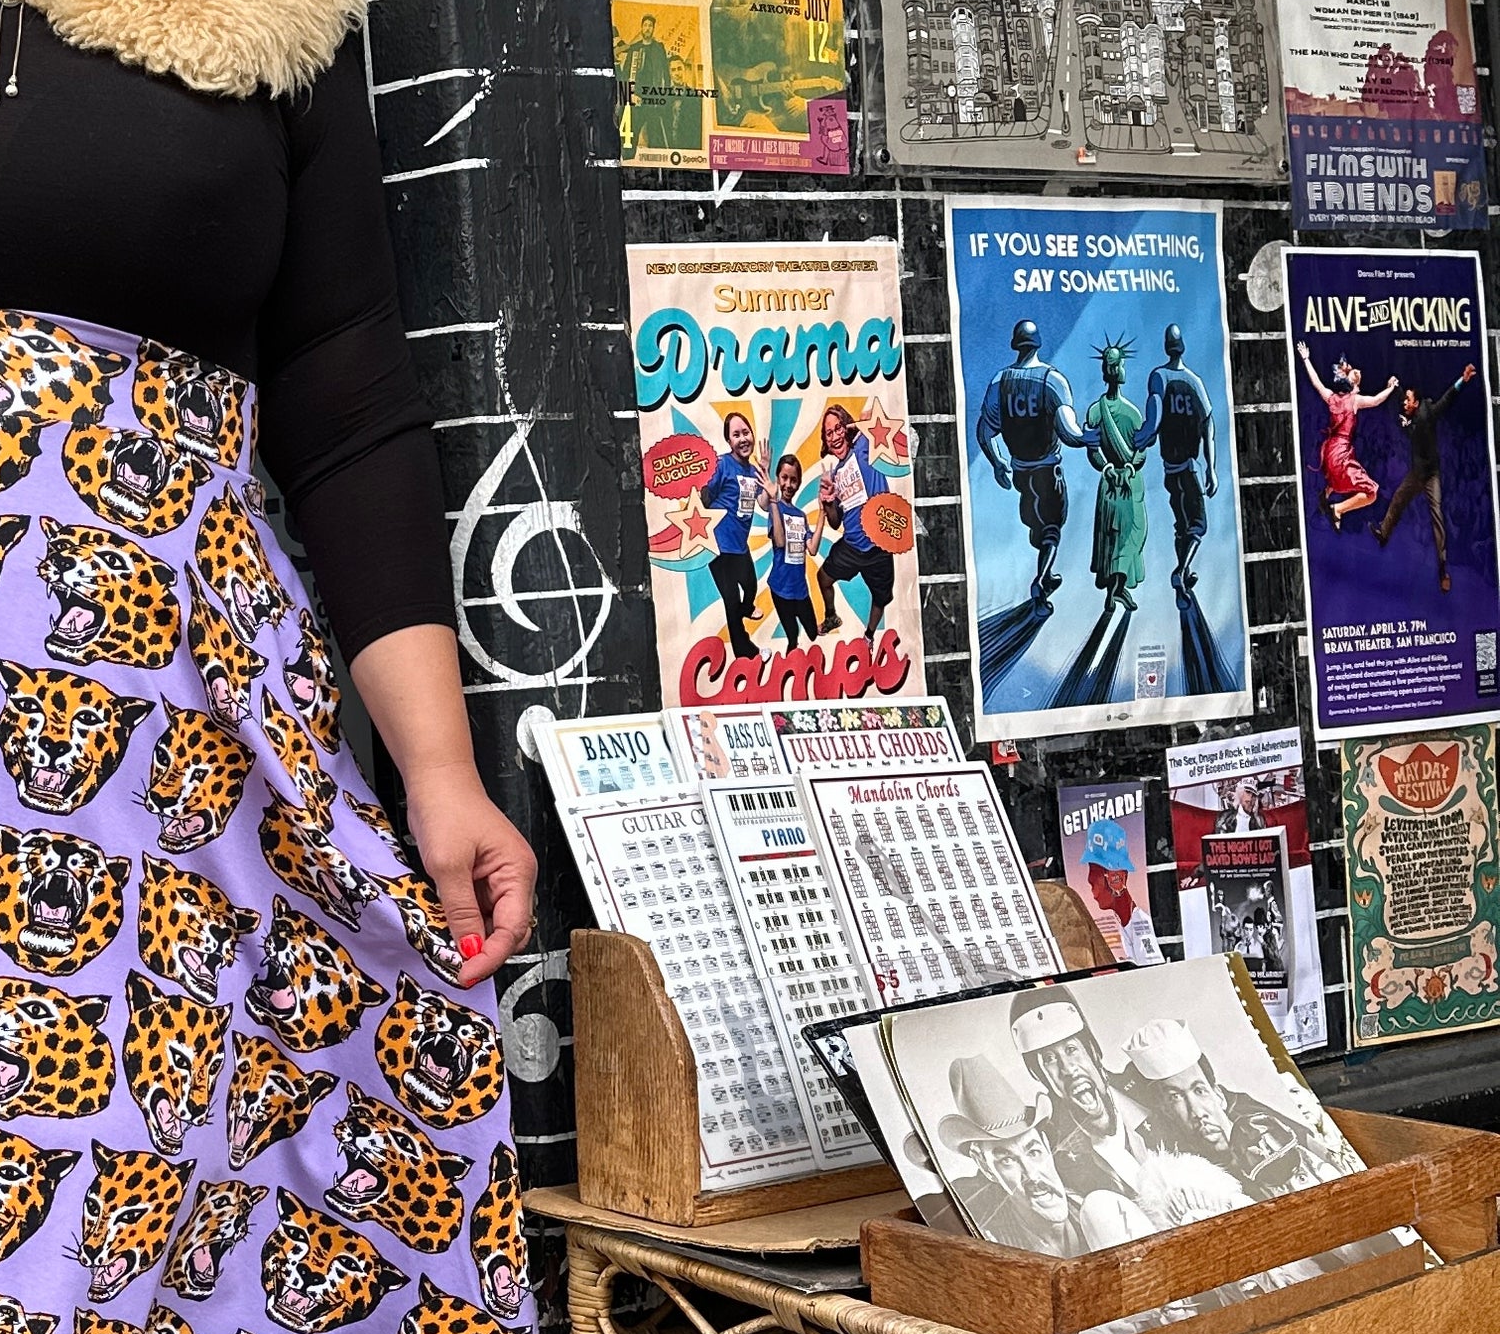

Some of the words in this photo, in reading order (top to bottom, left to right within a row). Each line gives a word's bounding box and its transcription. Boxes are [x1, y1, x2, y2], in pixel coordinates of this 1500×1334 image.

[1306, 182, 1433, 211] FRIENDS
[970, 233, 989, 257] IF
[995, 233, 1041, 257] YOU
[1046, 234, 1079, 257] SEE
[1087, 234, 1205, 262] SOMETHING,
[776, 261, 828, 273] THEATRE
[831, 260, 878, 272] CENTER
[1013, 270, 1054, 293] SAY
[1060, 269, 1180, 293] SOMETHING.
[714, 284, 833, 313] Summer
[1304, 296, 1369, 332] ALIVE
[1369, 302, 1389, 326] AND
[1390, 298, 1471, 331] KICKING
[636, 307, 903, 412] Drama
[1006, 393, 1039, 417] ICE
[1169, 394, 1195, 416] ICE
[654, 460, 710, 488] AUGUST
[1369, 621, 1394, 636] APRIL
[679, 628, 910, 707] Camps
[581, 732, 650, 763] BANJO
[728, 724, 753, 749] BASS
[792, 733, 875, 764] UKULELE
[879, 732, 949, 756] CHORDS
[1394, 761, 1420, 784] MAY
[1422, 761, 1450, 780] DAY
[847, 782, 913, 804] Mandolin
[916, 777, 961, 800] Chords
[1397, 780, 1450, 802] FESTIVAL
[622, 810, 687, 835] GUITAR
[1063, 807, 1087, 836] GET
[1088, 790, 1143, 821] HEARD!
[761, 828, 806, 847] PIANO
